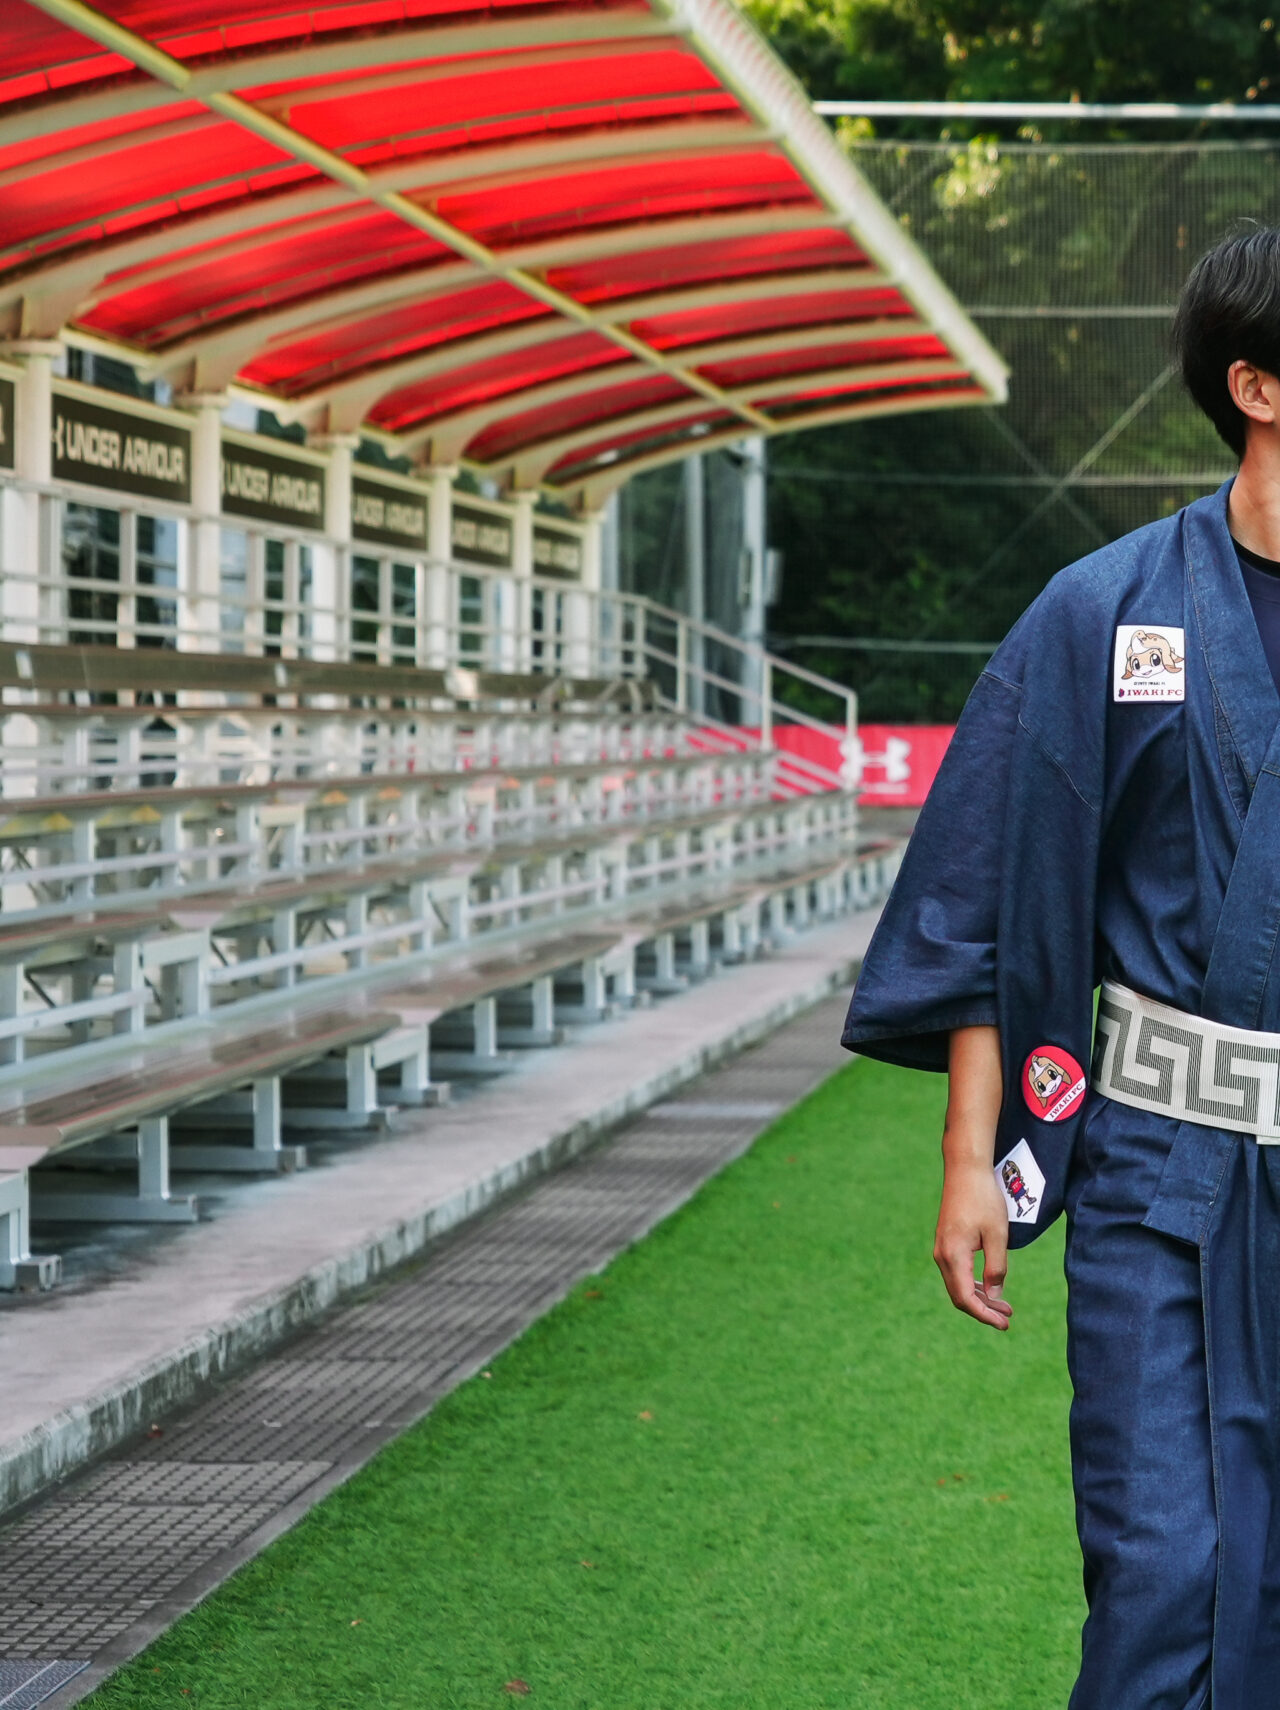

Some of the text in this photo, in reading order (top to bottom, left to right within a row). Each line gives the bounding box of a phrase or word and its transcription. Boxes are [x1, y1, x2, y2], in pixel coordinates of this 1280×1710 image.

[66, 420, 185, 483] UNDER ARMOUR
[1049, 1094, 1072, 1118] IWAKI
